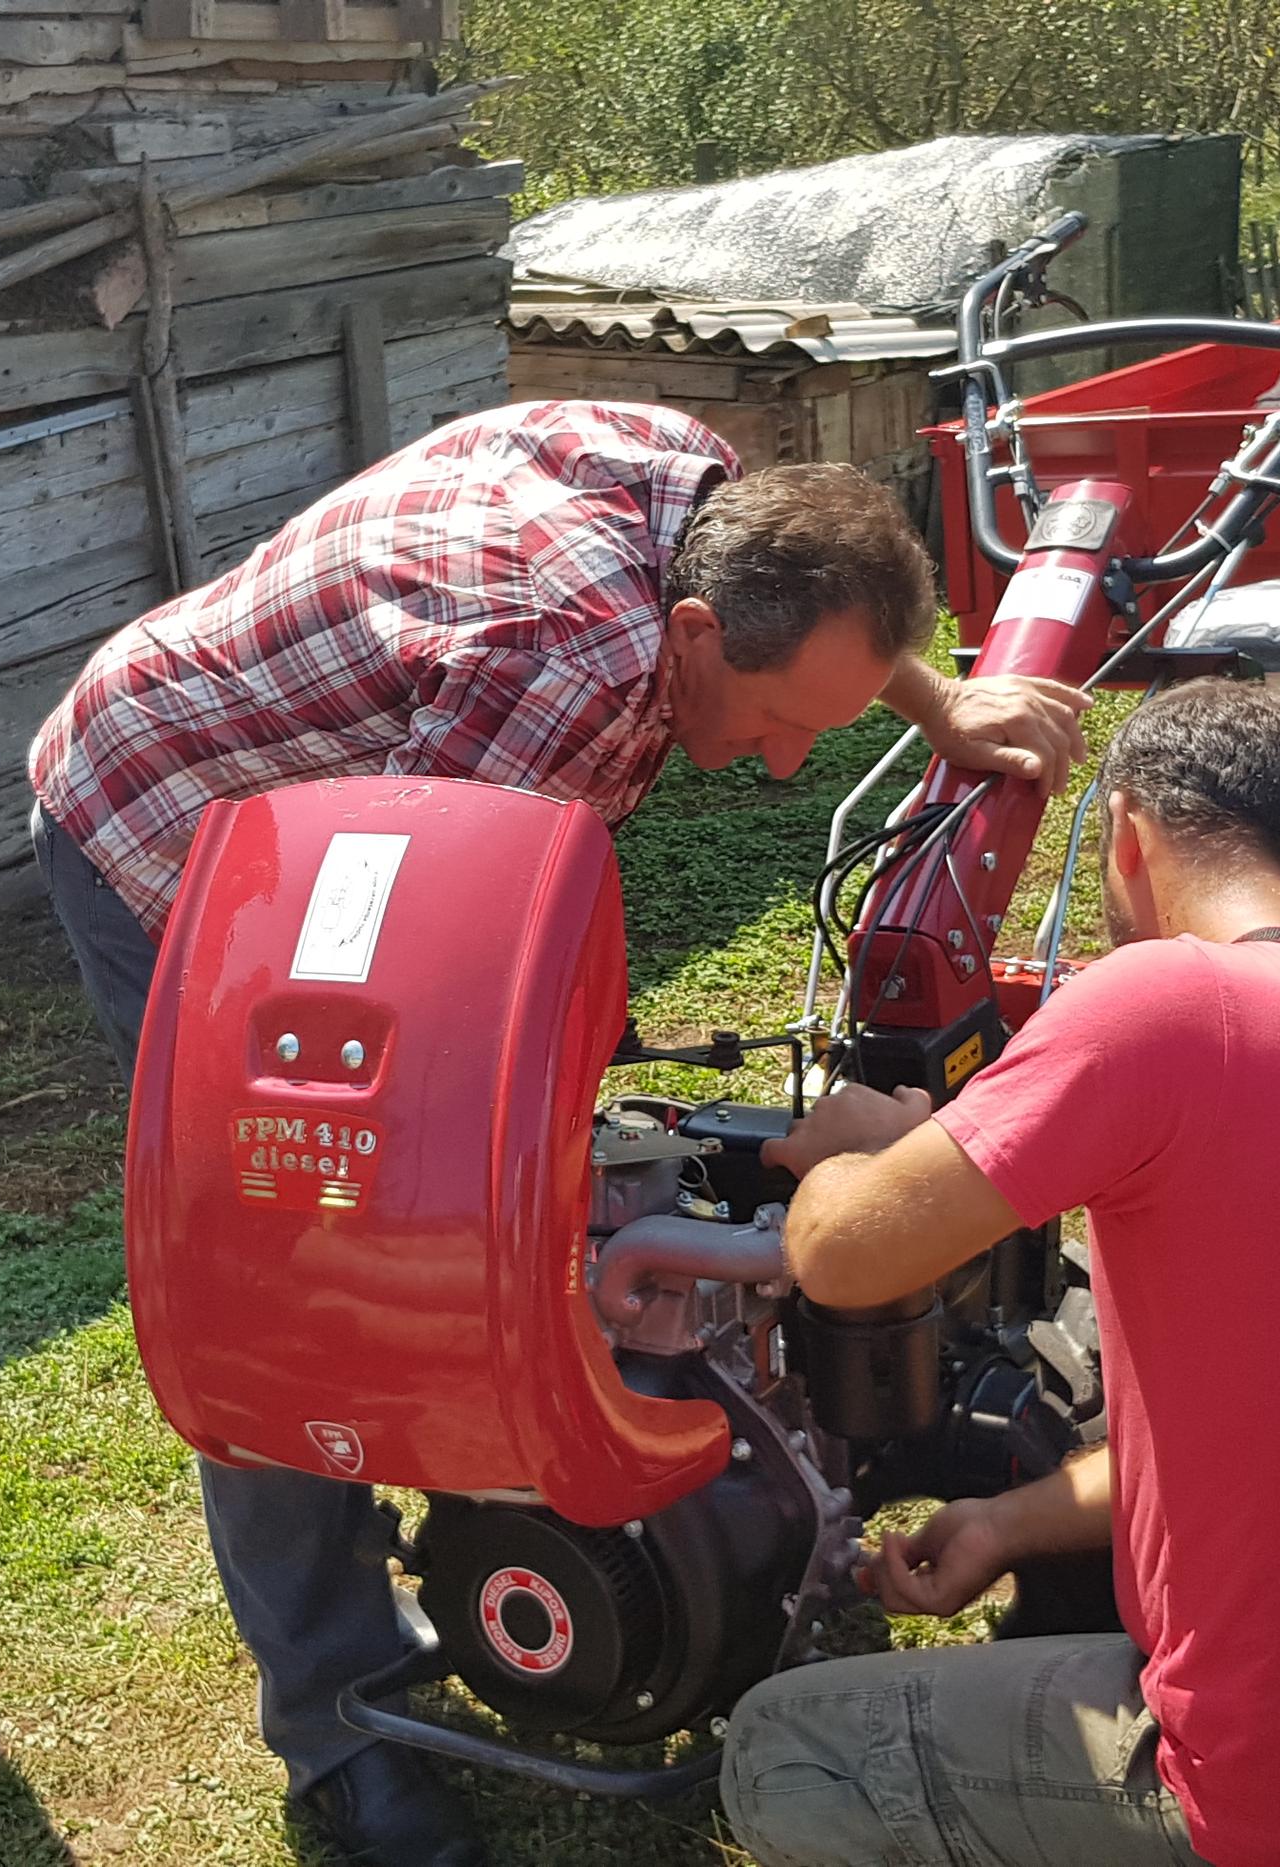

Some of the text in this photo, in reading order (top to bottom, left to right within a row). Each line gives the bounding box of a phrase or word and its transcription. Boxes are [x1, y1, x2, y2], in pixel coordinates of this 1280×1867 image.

[236, 1117, 376, 1154] FPM 410
[251, 1146, 349, 1178] diesel
[486, 1574, 518, 1607] DIESEL
[534, 1632, 568, 1667] DIESEL
